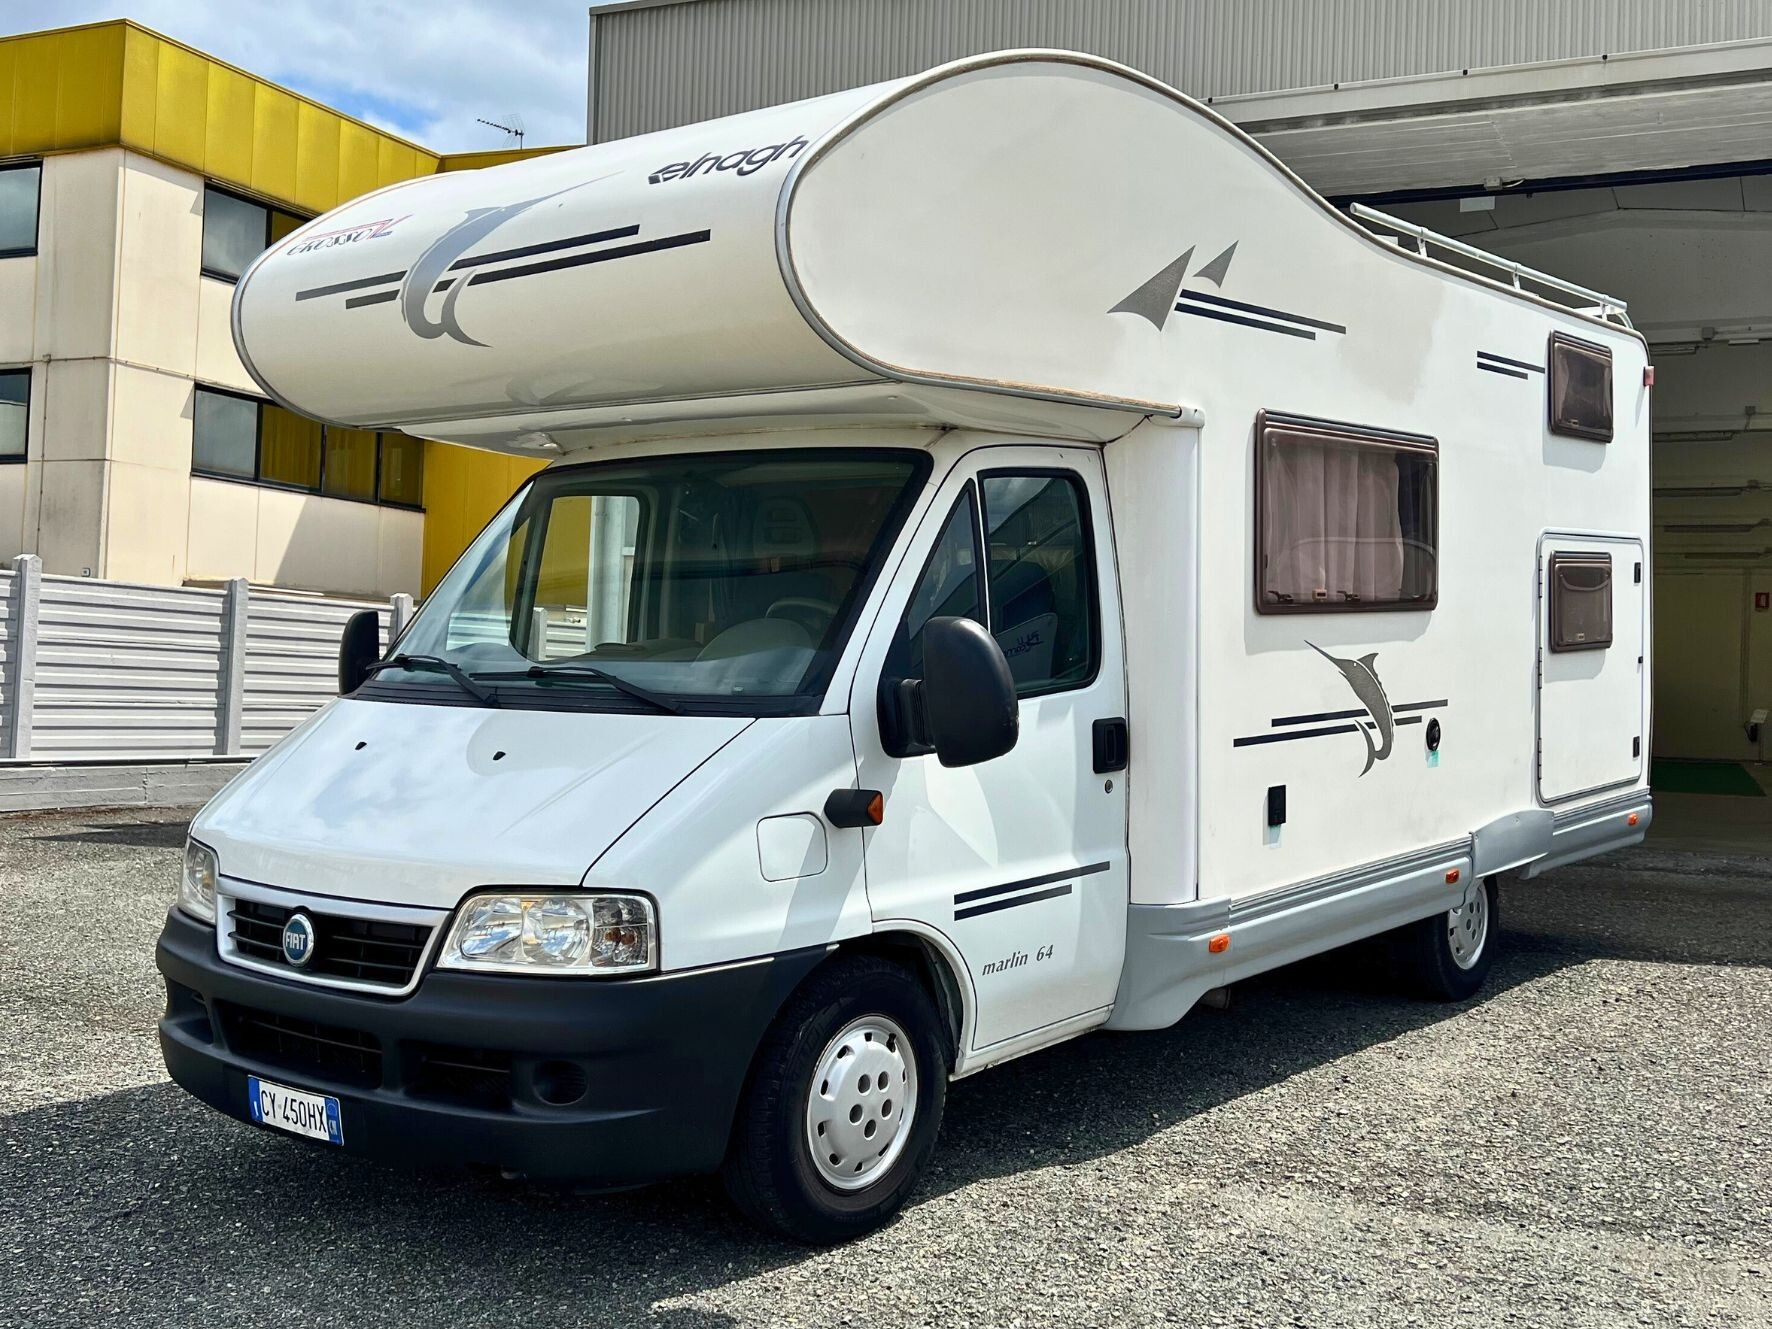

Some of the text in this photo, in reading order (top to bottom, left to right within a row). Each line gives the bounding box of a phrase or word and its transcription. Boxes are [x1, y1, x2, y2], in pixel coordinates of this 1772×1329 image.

[648, 135, 809, 184] elnagh
[285, 931, 306, 950] FIAT
[982, 944, 1054, 976] marlin 64
[261, 1090, 327, 1133] CY 450HX
